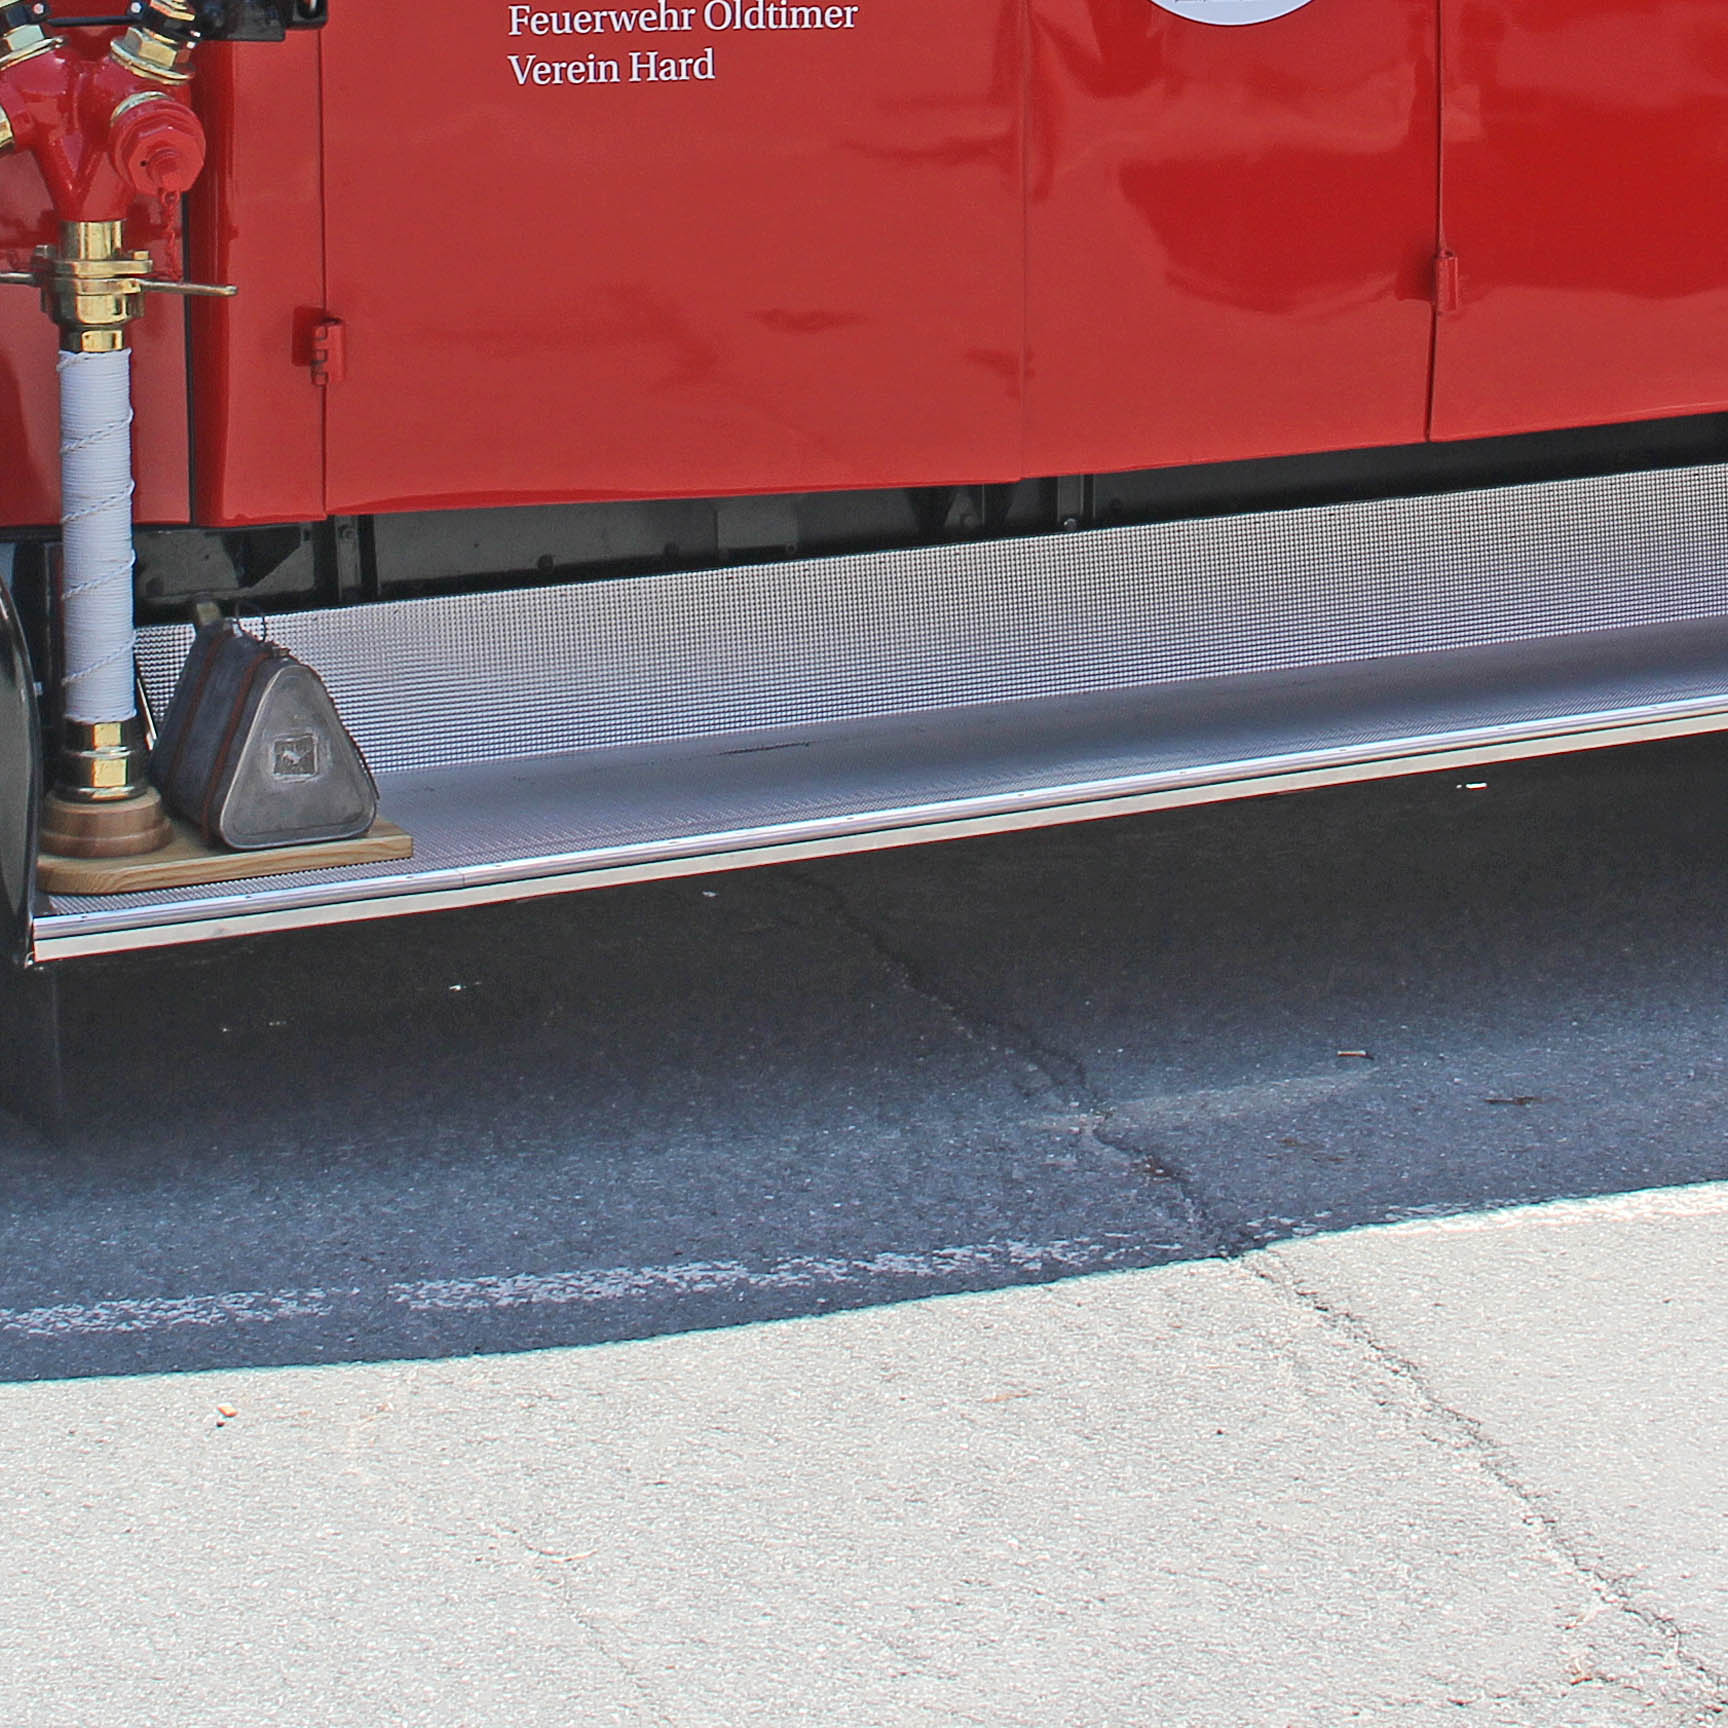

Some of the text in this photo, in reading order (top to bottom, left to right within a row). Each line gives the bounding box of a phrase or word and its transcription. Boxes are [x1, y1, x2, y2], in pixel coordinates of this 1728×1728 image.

[508, 0, 697, 36] Feuerwehr
[508, 47, 716, 86] Verein Hard
